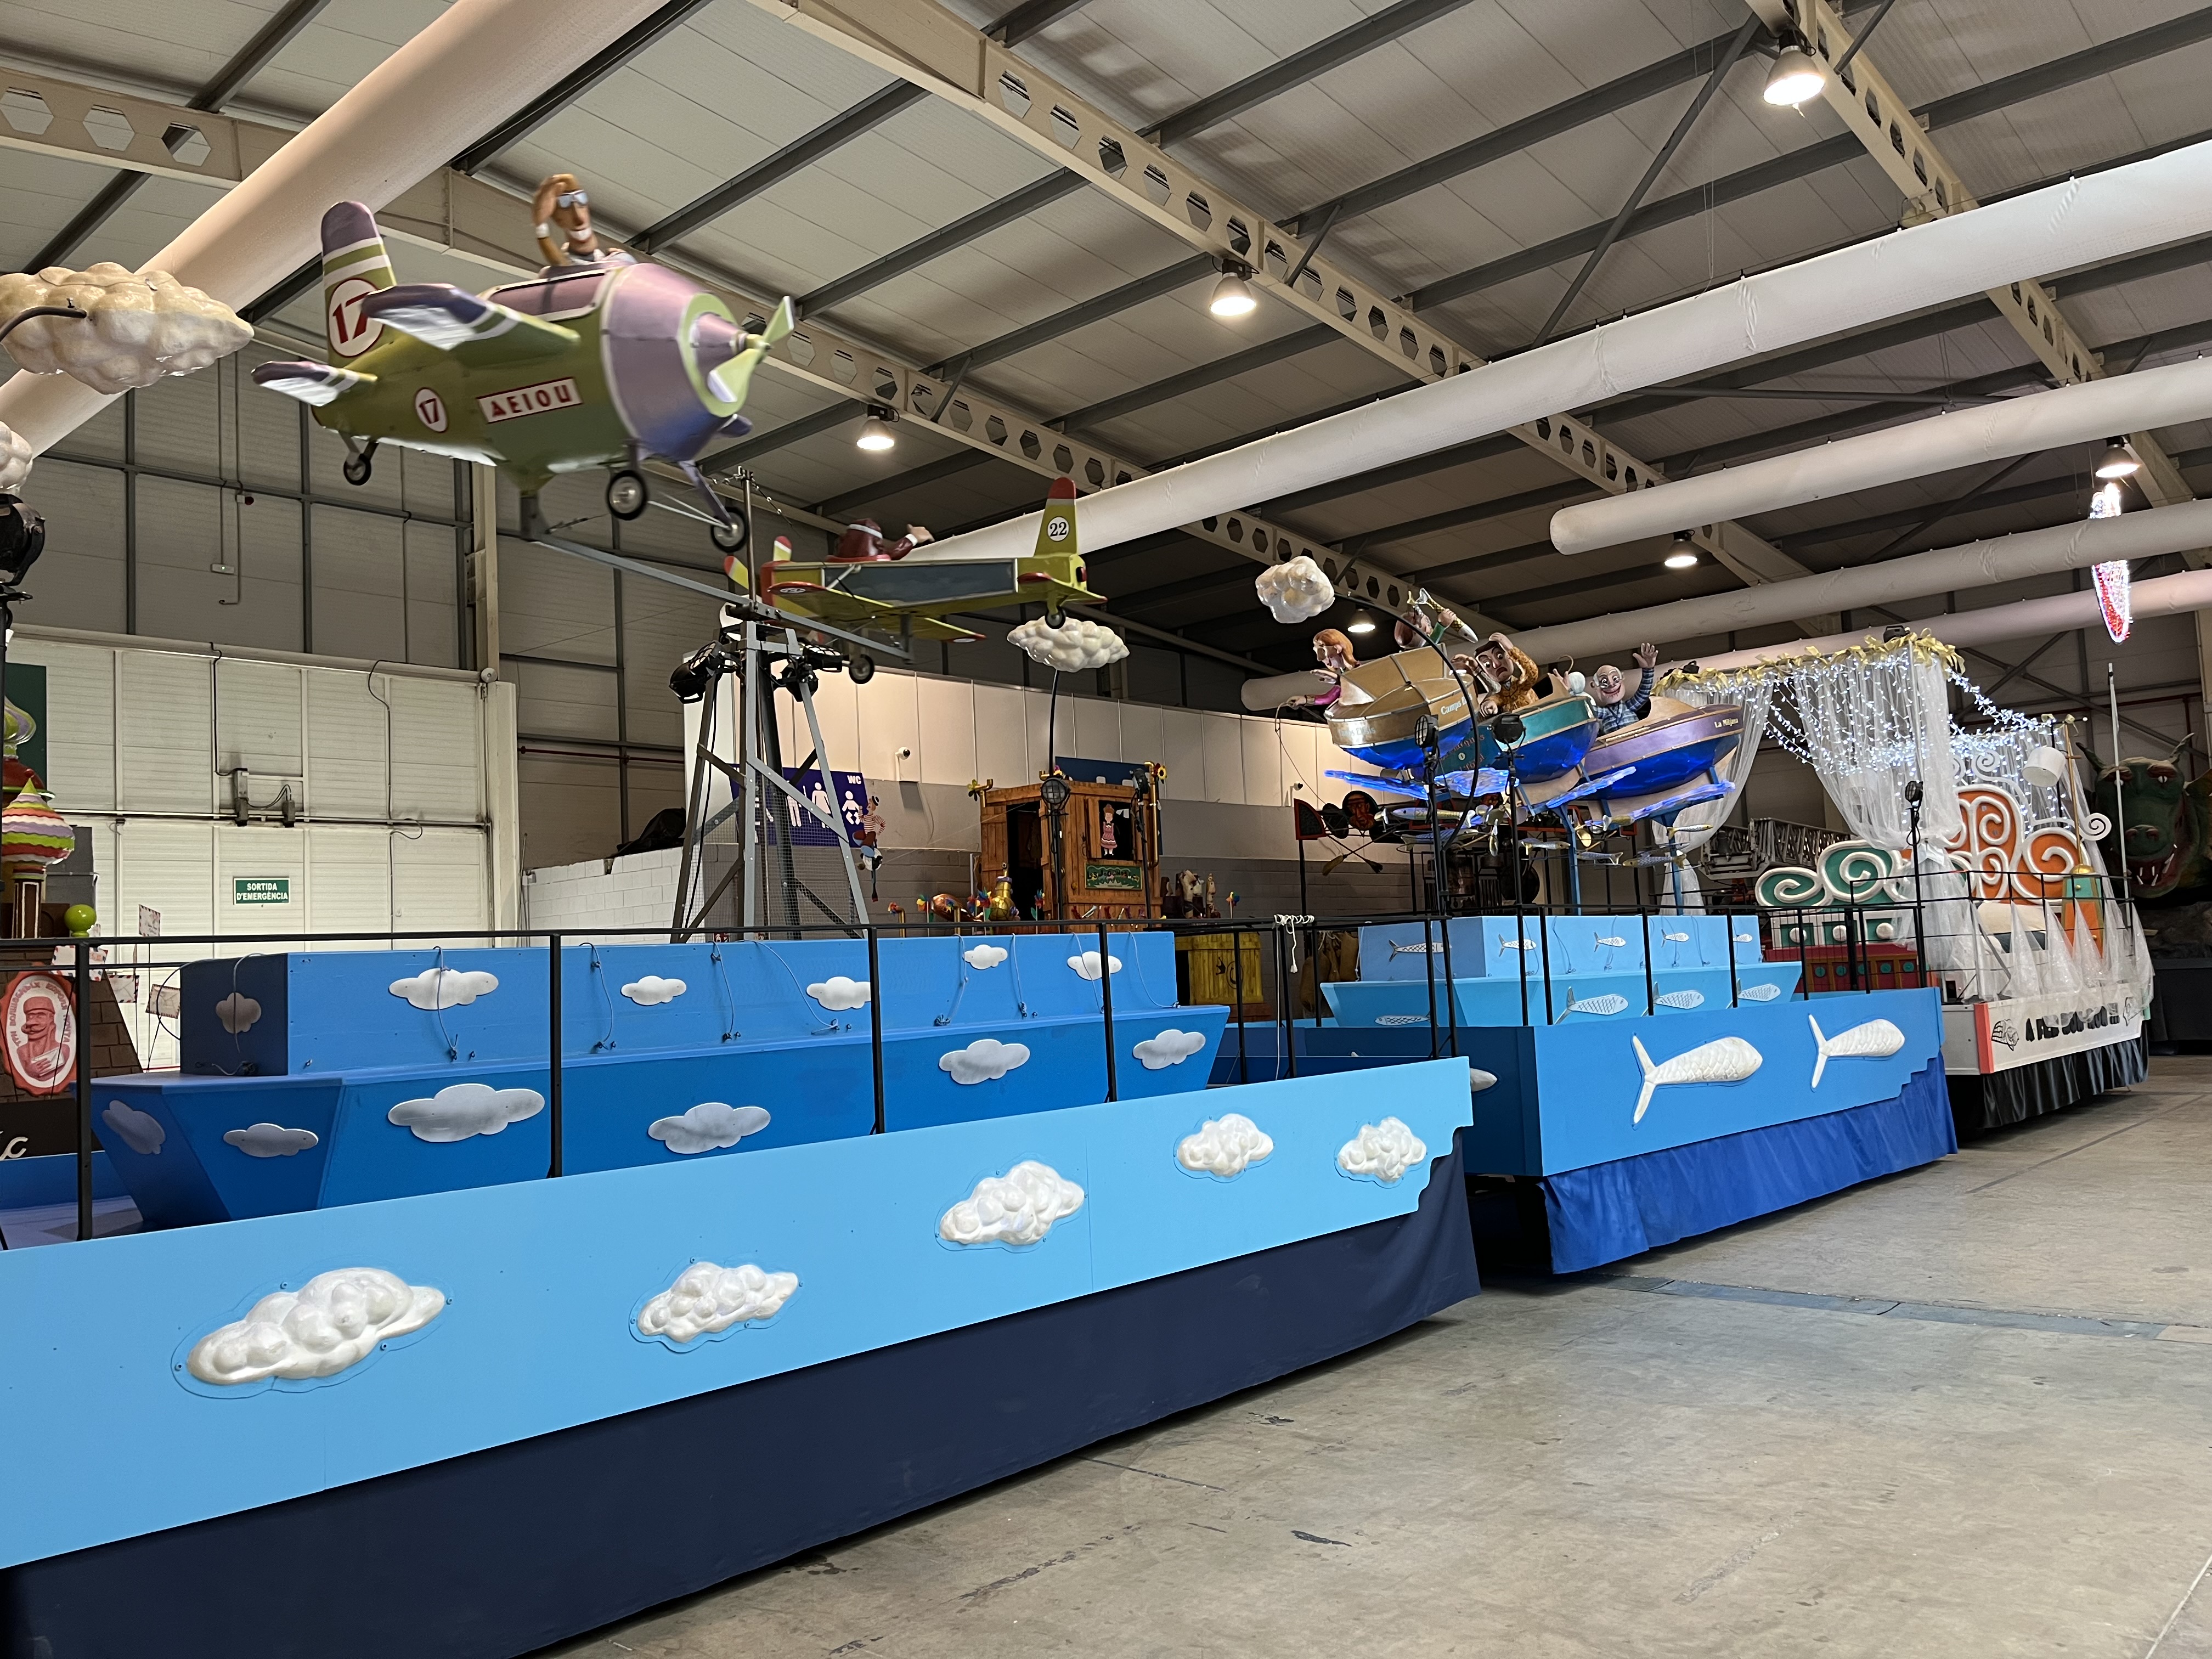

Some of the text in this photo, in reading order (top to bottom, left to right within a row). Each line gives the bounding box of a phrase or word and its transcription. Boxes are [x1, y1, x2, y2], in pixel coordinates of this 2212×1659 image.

[332, 291, 371, 344] 17
[491, 385, 572, 417] AEIOU
[419, 398, 439, 424] 17
[1049, 522, 1067, 537] 22
[847, 775, 862, 785] WC
[236, 891, 288, 901] D'EMERGÈNCIA
[247, 883, 278, 891] SORTIDA
[2025, 1018, 2035, 1042] A
